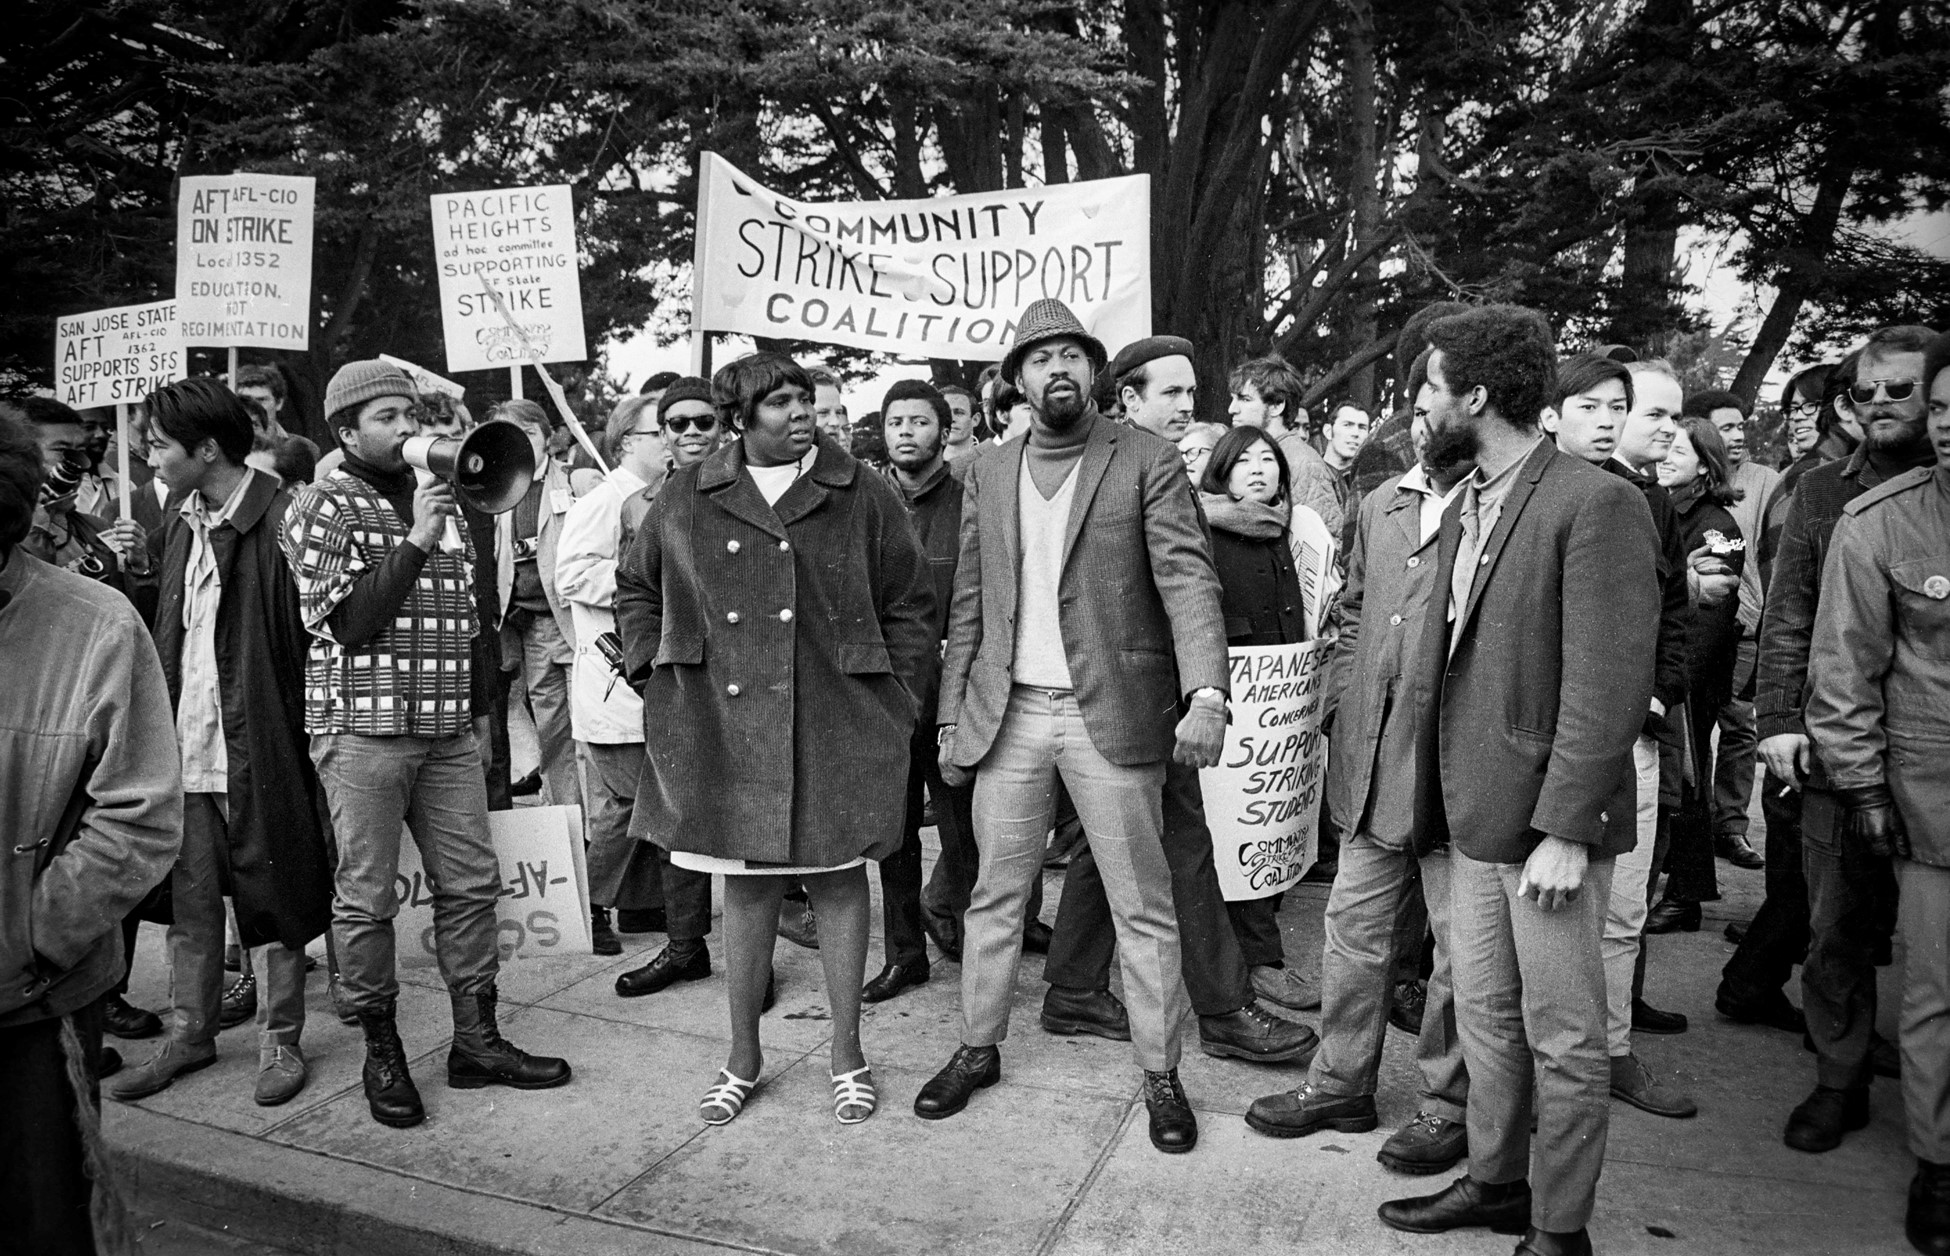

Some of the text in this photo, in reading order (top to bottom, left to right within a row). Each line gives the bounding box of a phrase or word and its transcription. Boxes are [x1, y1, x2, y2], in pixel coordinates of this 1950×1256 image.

[192, 187, 298, 214] AFT AFL-CIO
[447, 193, 549, 219] PACIFIC
[192, 216, 293, 244] ON STRIKE
[449, 216, 552, 240] HEIGHTS
[774, 199, 1045, 245] COMMUNITY
[236, 251, 280, 268] 1352
[443, 239, 553, 258] ad hoc committee
[444, 253, 567, 277] SUPPORTING
[738, 218, 1123, 310] STRIKE SUPPORT
[507, 274, 542, 286] State
[226, 300, 247, 316] NOT
[60, 305, 177, 338] SAN JOSE STATE
[122, 327, 167, 340] AFL-CIO
[182, 321, 304, 339] REGIMENTATION
[64, 335, 105, 363] AFT
[128, 342, 156, 355] 1362
[62, 351, 178, 385] SUPPORTS SFS
[67, 381, 98, 404] AFT
[1226, 725, 1322, 768] SUPPOR
